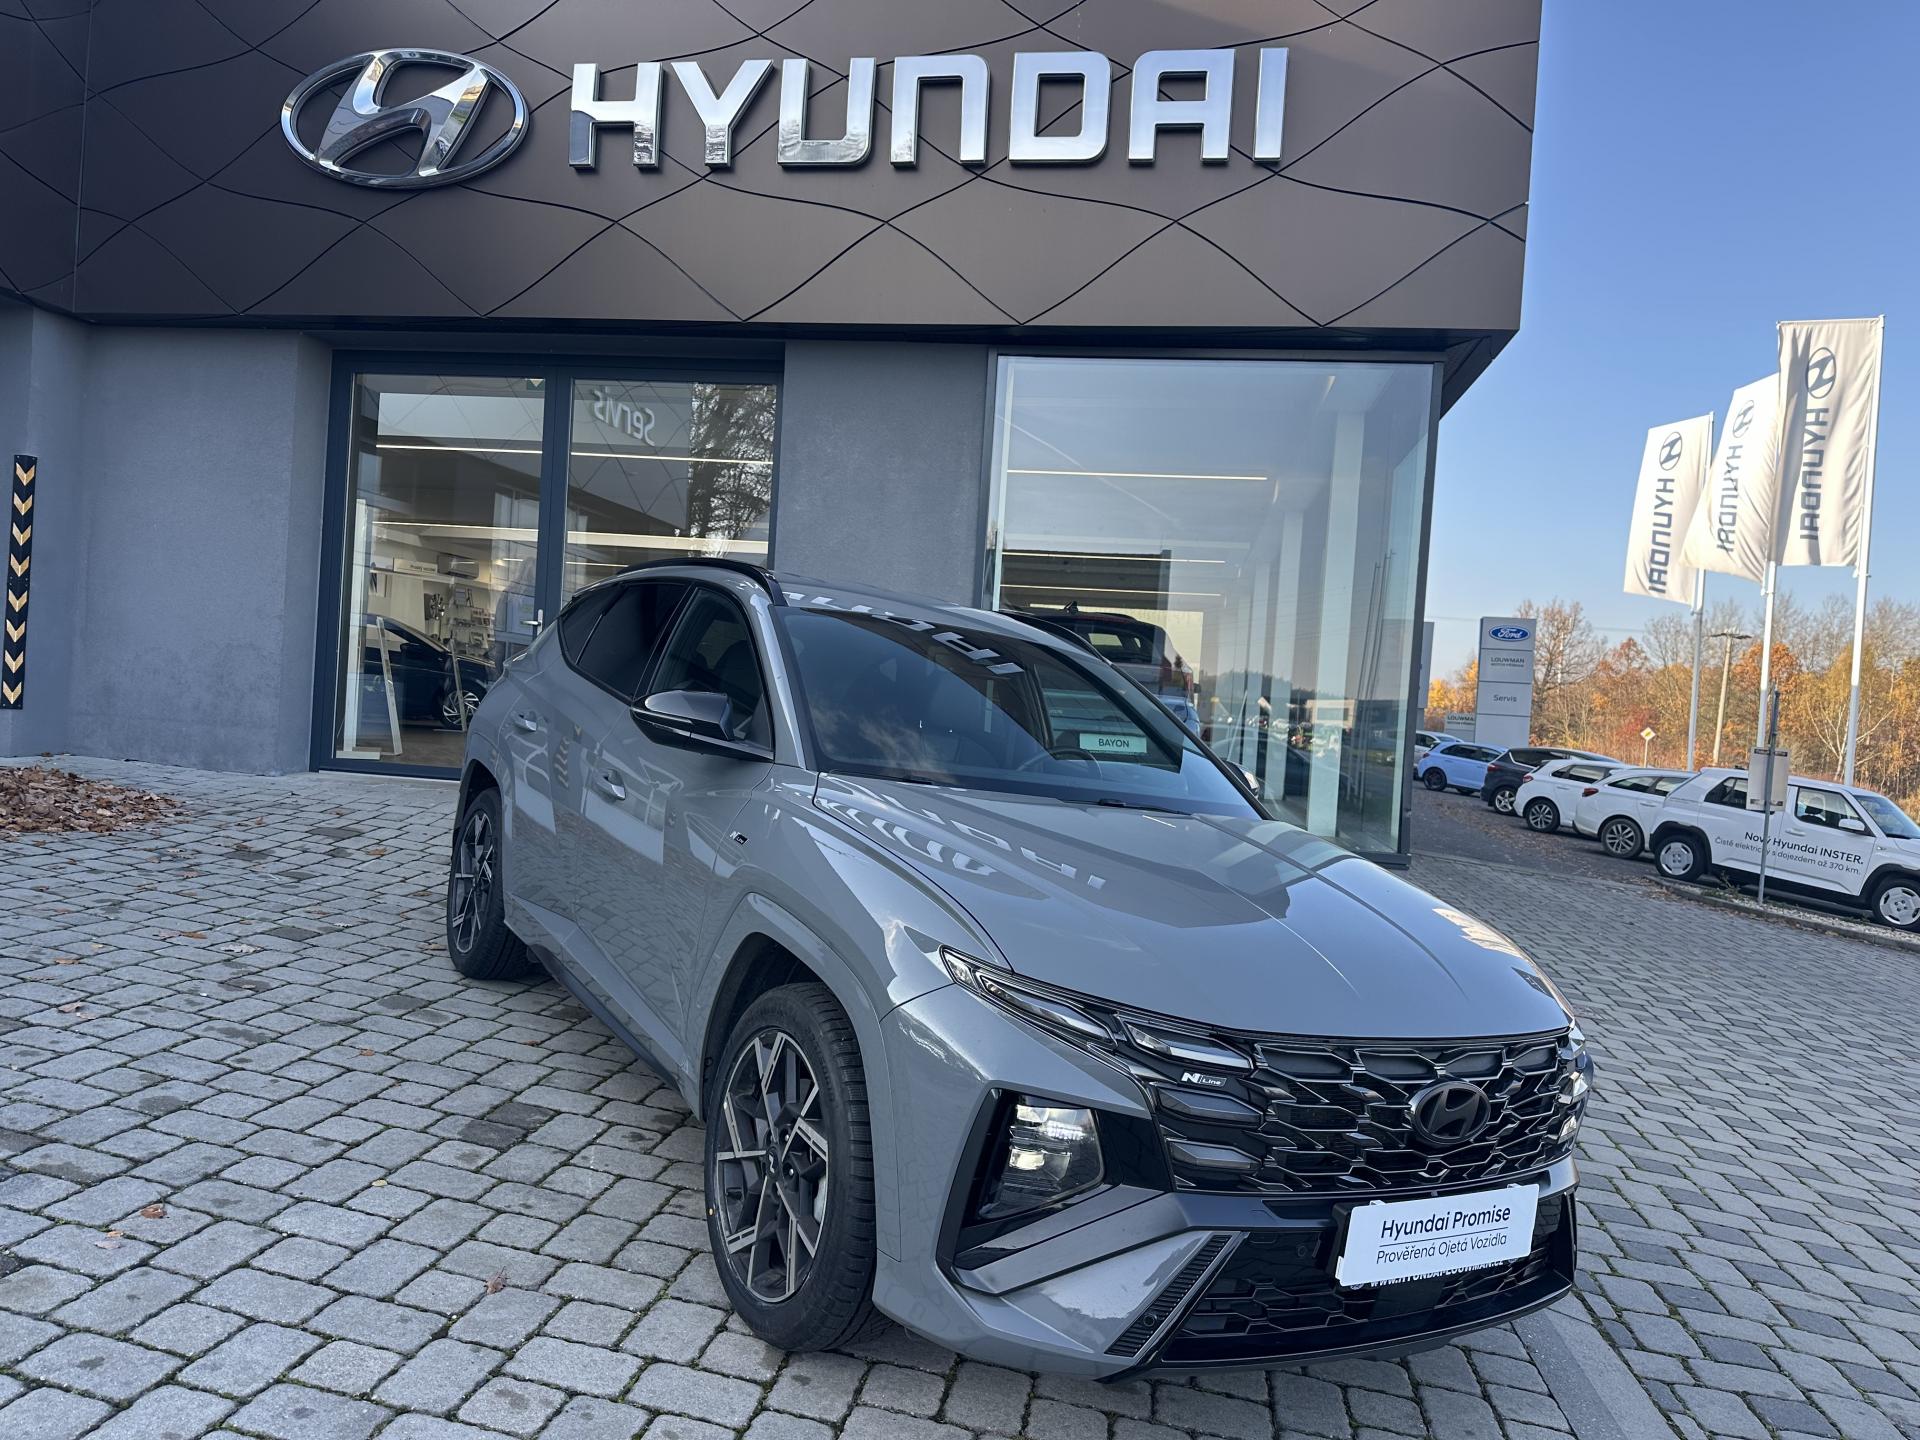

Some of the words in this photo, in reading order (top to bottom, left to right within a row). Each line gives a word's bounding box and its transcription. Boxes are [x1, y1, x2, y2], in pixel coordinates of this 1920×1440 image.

[570, 46, 1290, 171] HYUNDAI
[1490, 656, 1525, 664] LOUWMAN
[1493, 694, 1518, 702] Servis
[1098, 738, 1130, 748] BAYON
[1772, 837, 1819, 854] Hyundai
[1820, 847, 1864, 865] INSTER.
[1777, 850, 1816, 865] dojezdem
[1817, 858, 1828, 868] až
[1828, 861, 1844, 871] 370
[1380, 1211, 1450, 1241] Hyundai
[1452, 1204, 1511, 1229] Promise
[1376, 1243, 1435, 1265] Prověřená
[1438, 1239, 1467, 1257] Ojetá
[1470, 1233, 1507, 1250] Vozidla
